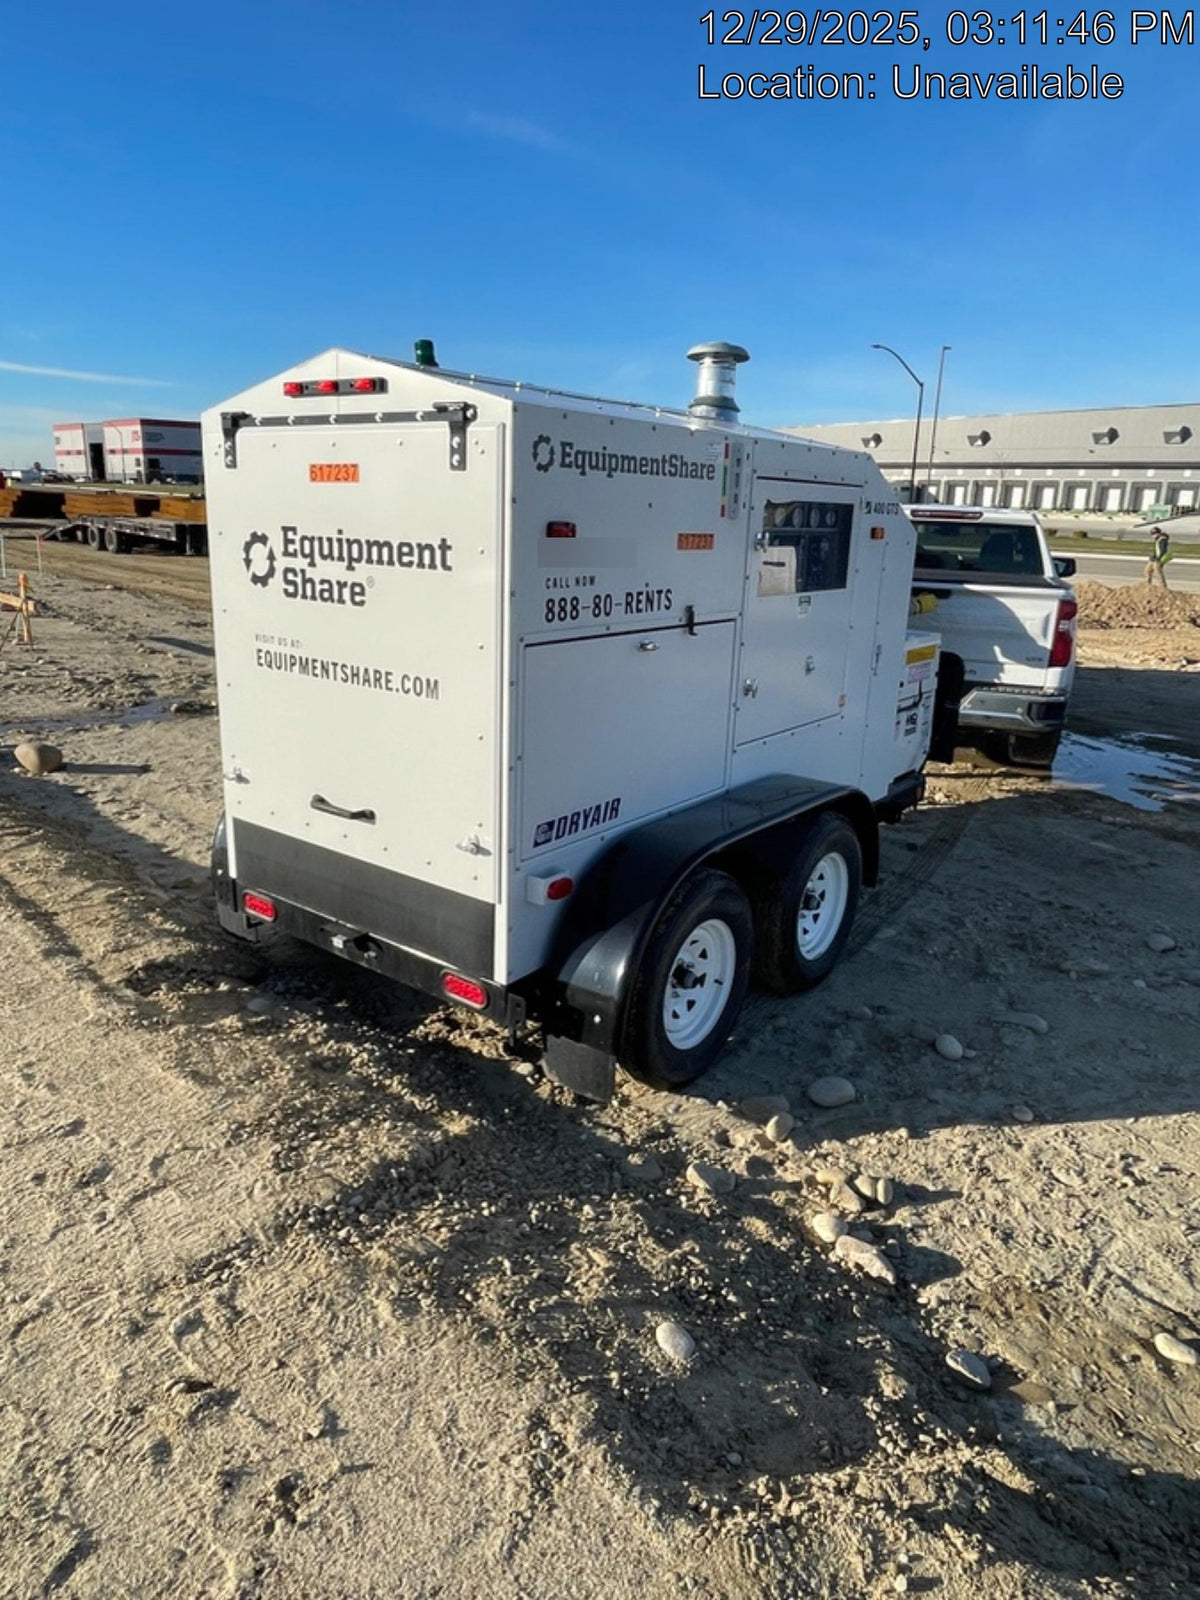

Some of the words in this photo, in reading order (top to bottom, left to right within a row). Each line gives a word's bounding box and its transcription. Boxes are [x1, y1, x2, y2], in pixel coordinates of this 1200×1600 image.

[309, 464, 359, 483] 617237
[559, 441, 716, 480] EquipmentShare
[281, 525, 452, 572] Equipment
[545, 577, 570, 590] CALL
[575, 575, 596, 588] NOW
[545, 588, 673, 623] 888-80-RENTS
[256, 648, 440, 701] EQUIPMENTSHARE.COM
[554, 797, 622, 841] DRYAIR
